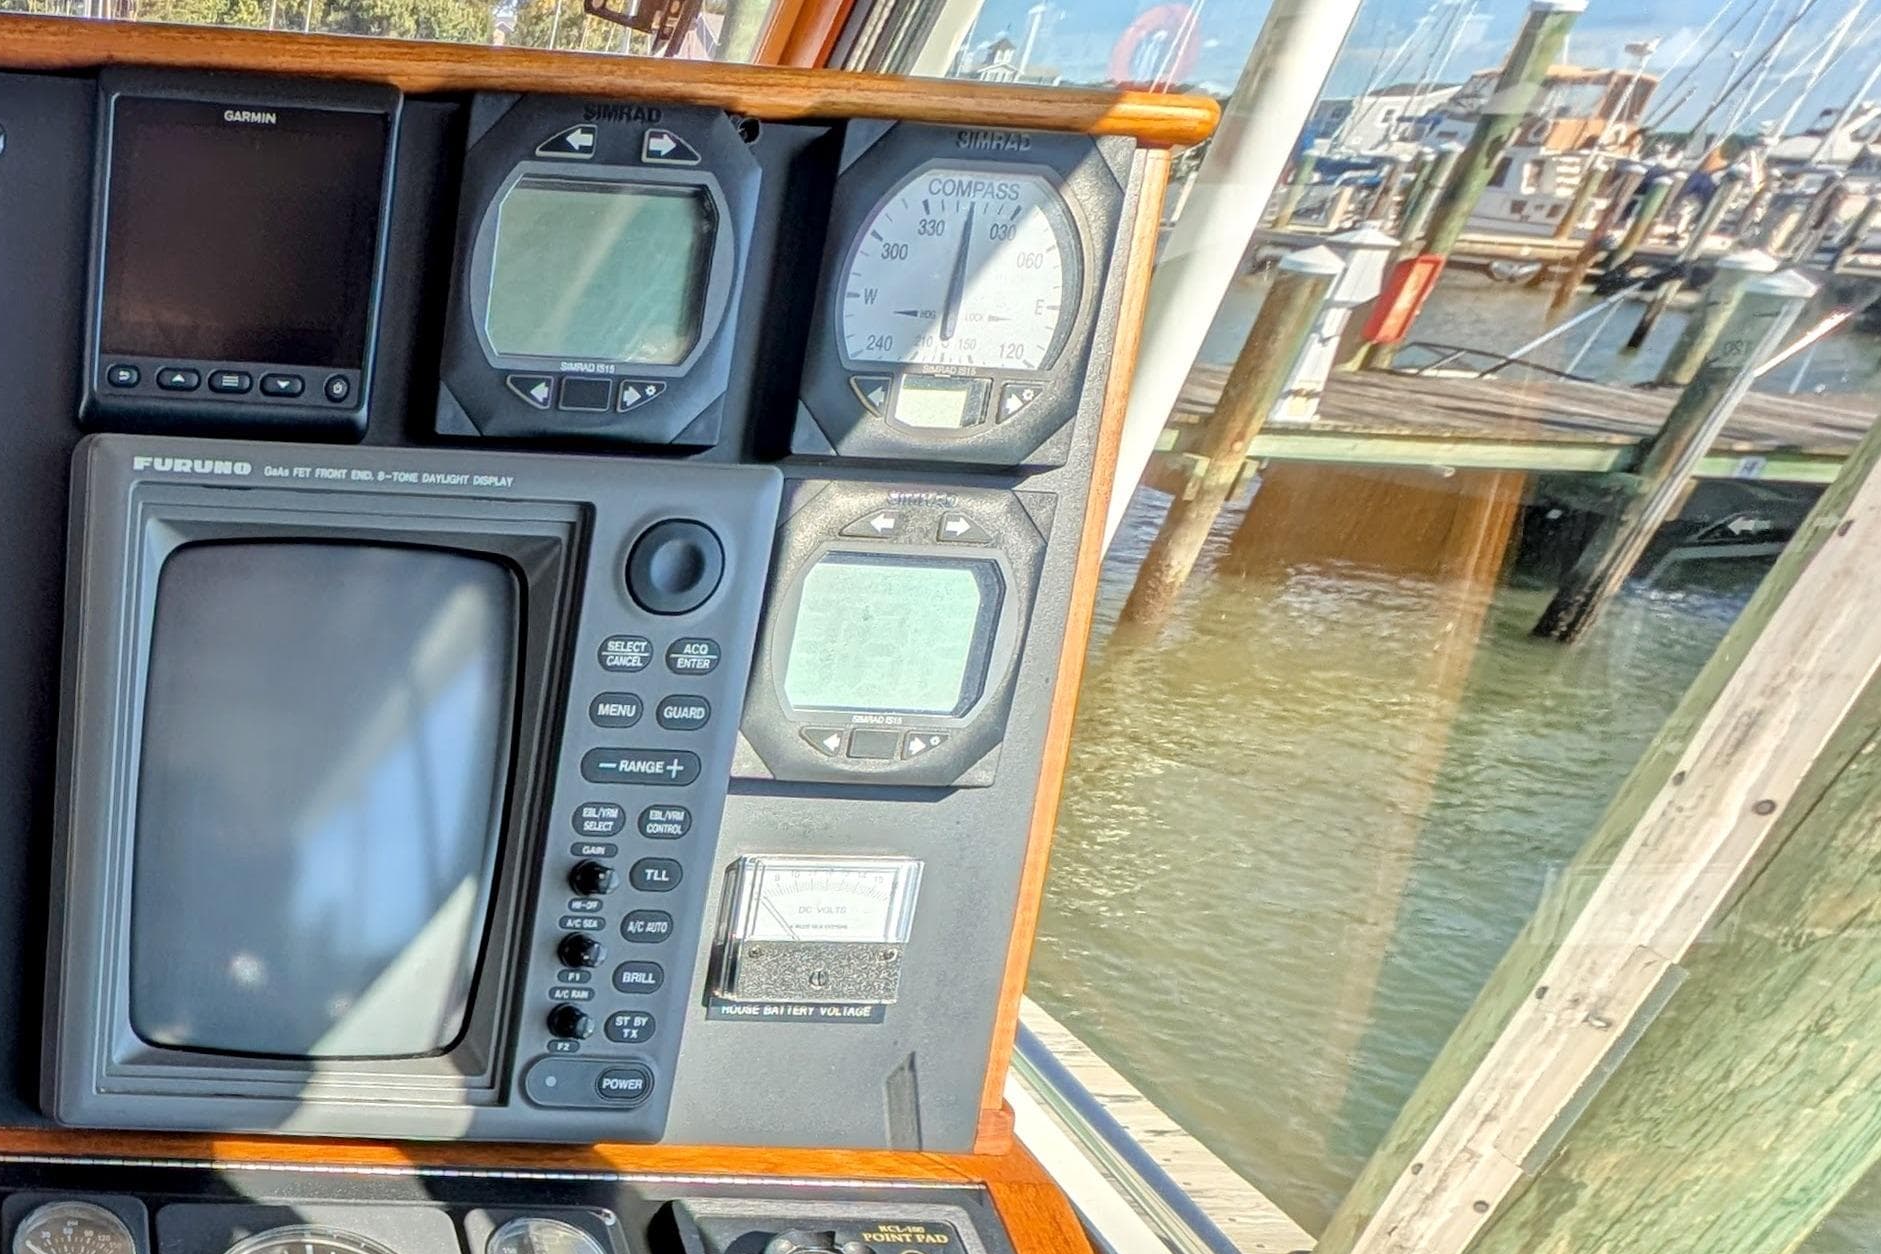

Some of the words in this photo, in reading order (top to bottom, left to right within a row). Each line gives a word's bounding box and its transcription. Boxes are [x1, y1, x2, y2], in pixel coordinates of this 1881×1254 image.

[224, 110, 276, 124] GARMIN
[583, 103, 663, 123] SIMRAD
[957, 132, 1031, 151] SIMRAD
[928, 178, 1021, 201] COMPASS
[918, 218, 945, 237] 330
[990, 223, 1017, 241] 030
[881, 242, 909, 261] 300
[1016, 252, 1044, 270] 060
[864, 288, 879, 305] W
[1034, 299, 1045, 315] E
[866, 335, 894, 351] 240
[958, 338, 977, 350] 150
[1000, 344, 1024, 360] 120
[561, 361, 595, 372] SIMRAD
[922, 364, 957, 375] SIMRAD
[133, 455, 252, 476] FURUNO
[293, 467, 311, 478] FET
[315, 469, 348, 480] FRONT
[377, 470, 418, 484] 8-TONE
[422, 473, 469, 486] DAYLIGHT
[473, 474, 514, 488] DISPLAY
[607, 641, 646, 653] SELECT
[683, 644, 709, 655] ACQ
[606, 656, 643, 667] CANCEL
[677, 658, 710, 669] ENTER
[597, 704, 636, 717] MENU
[664, 706, 705, 719] GUARD
[619, 760, 664, 774] RANGE
[583, 821, 614, 832] SELECT
[646, 824, 682, 835] CONTROL
[582, 845, 606, 856] GAIN
[645, 870, 670, 882] TLL
[817, 906, 847, 915] VOLTS
[566, 918, 582, 929] A/C
[582, 918, 599, 929] SEA
[627, 922, 645, 933] A/C
[645, 922, 668, 934] AUTO
[568, 972, 581, 982] F1
[622, 972, 656, 984] BRILL
[554, 989, 570, 999] A/C
[570, 989, 589, 1000] RAIN
[721, 1005, 760, 1016] HOUSE
[763, 1005, 814, 1017] BATTERY
[820, 1006, 872, 1018] VOLTAGE
[615, 1016, 630, 1027] ST
[633, 1016, 649, 1027] BY
[622, 1029, 639, 1039] TX
[557, 1042, 570, 1051] F2
[602, 1078, 643, 1090] POWER
[862, 1233, 915, 1243] POINT
[916, 1234, 949, 1244] PAD
